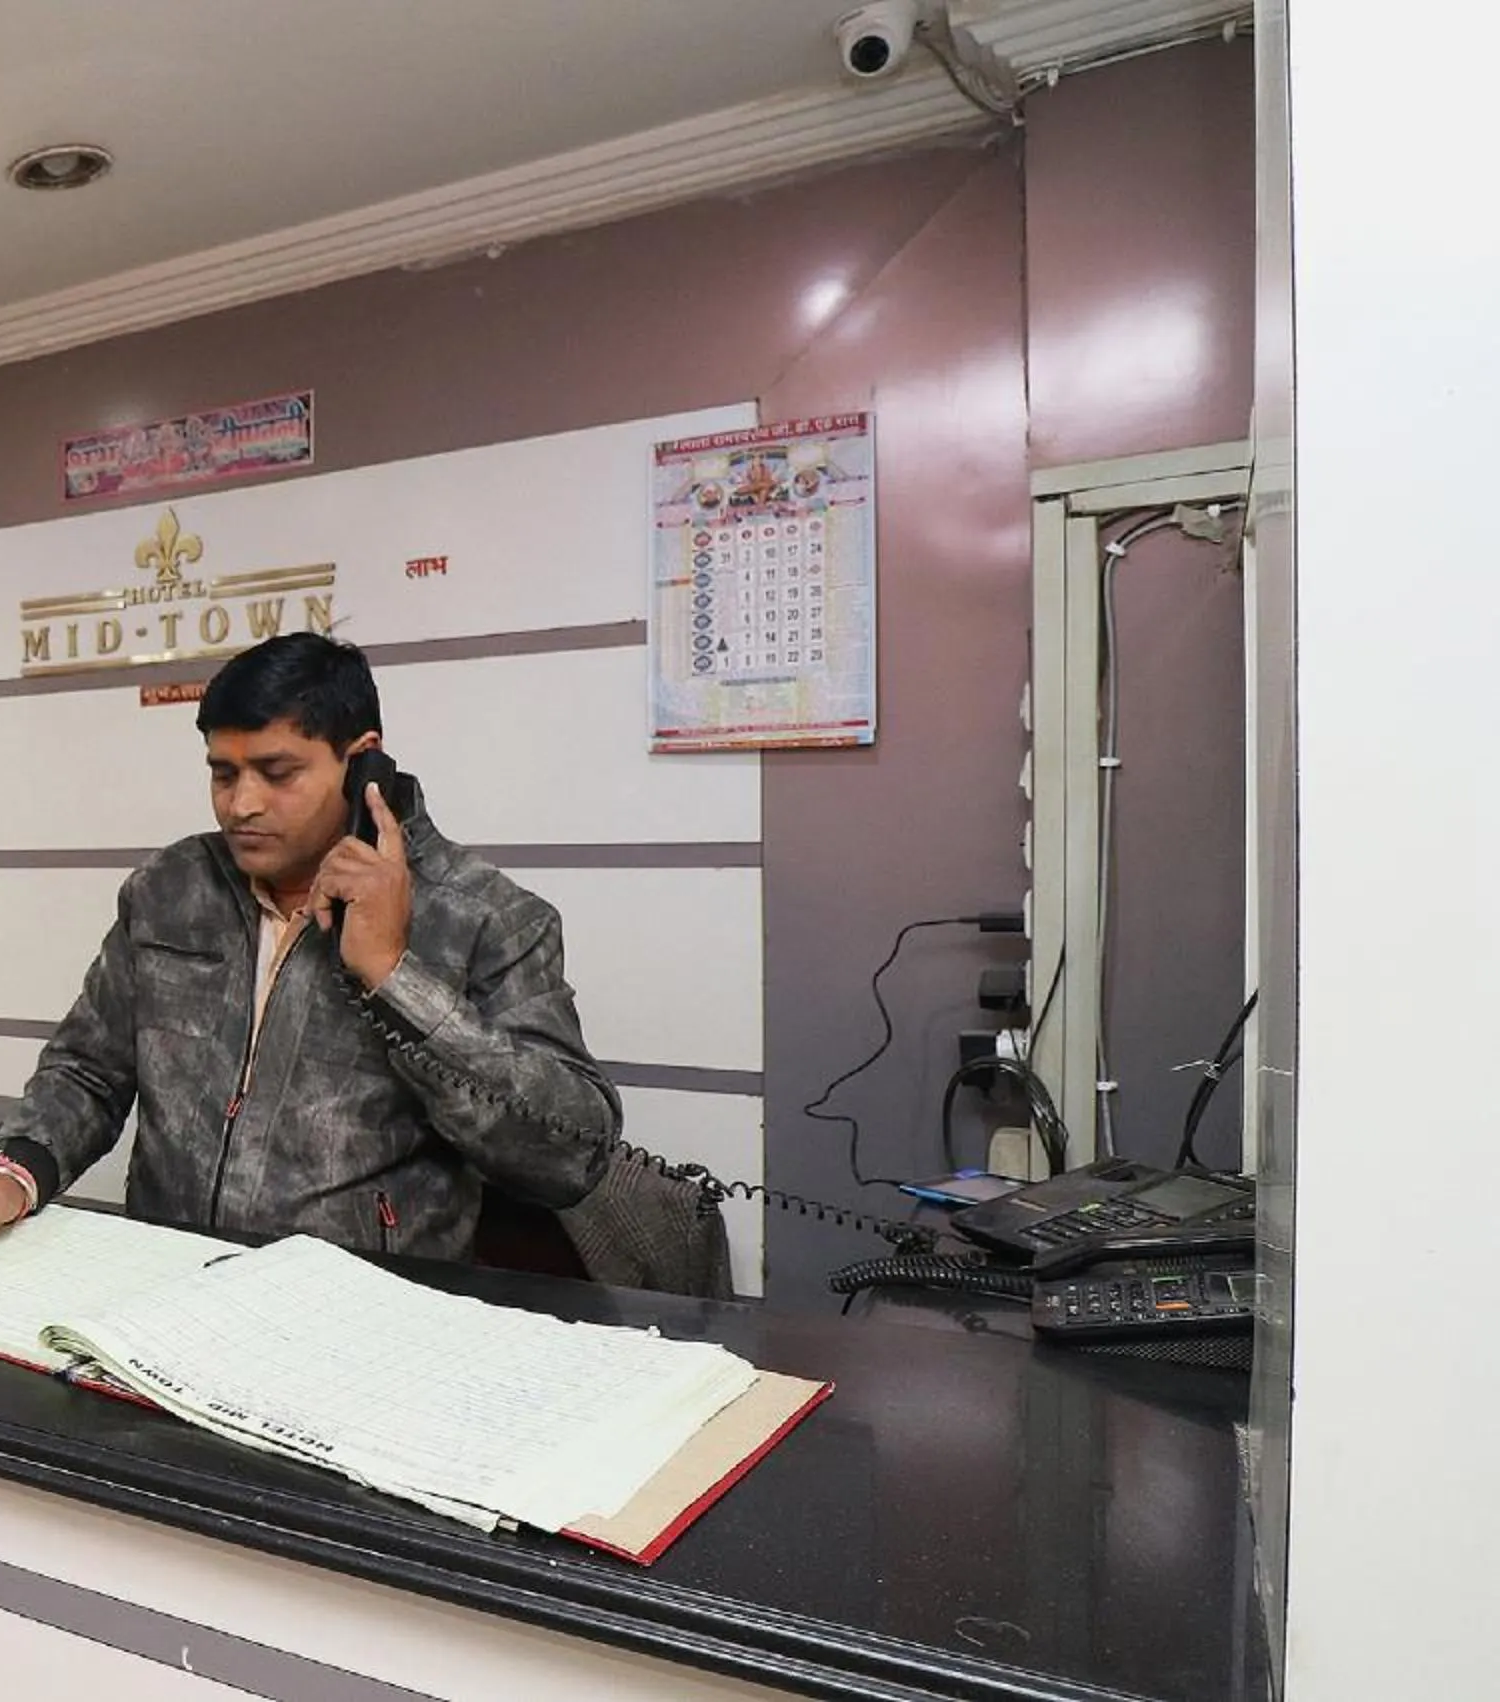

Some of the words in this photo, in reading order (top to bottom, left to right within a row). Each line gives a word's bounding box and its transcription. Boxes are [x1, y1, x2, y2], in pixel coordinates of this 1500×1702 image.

[404, 555, 449, 580] लाभ
[125, 579, 207, 606] HOTEL
[128, 1357, 184, 1395] TOWN
[261, 1421, 335, 1453] HOTEL
